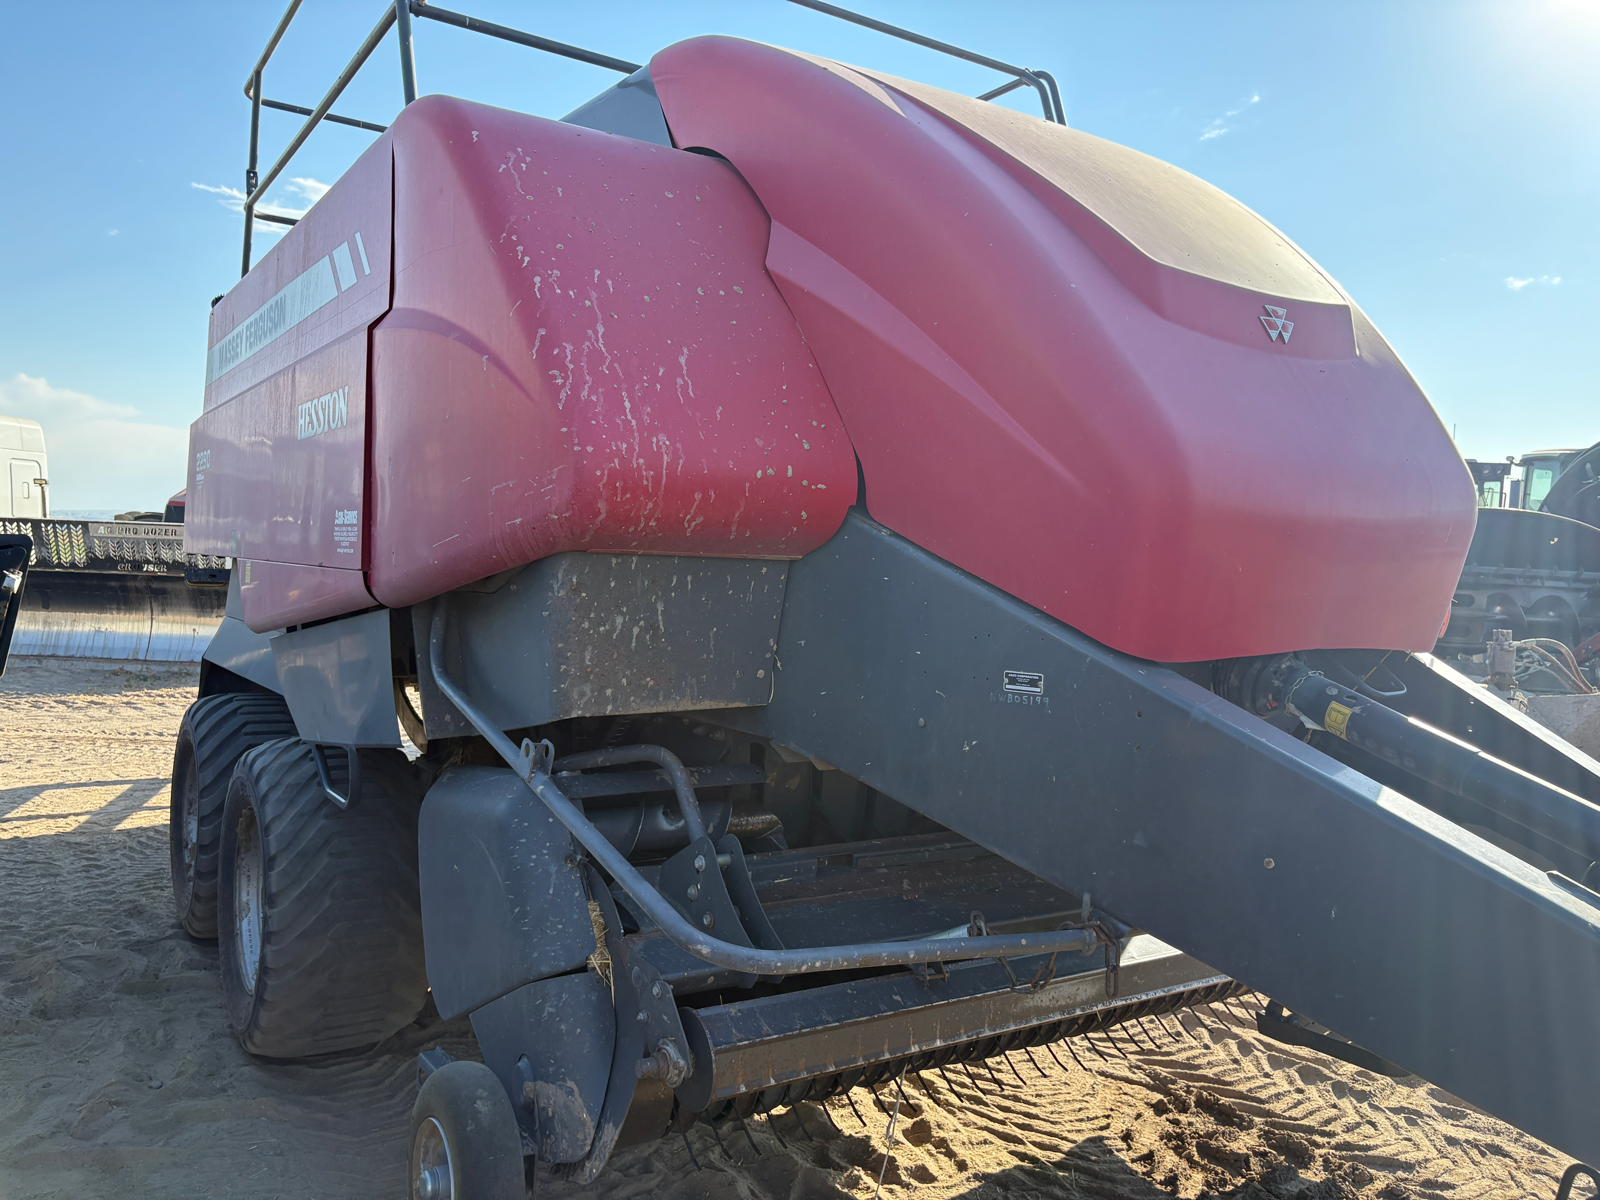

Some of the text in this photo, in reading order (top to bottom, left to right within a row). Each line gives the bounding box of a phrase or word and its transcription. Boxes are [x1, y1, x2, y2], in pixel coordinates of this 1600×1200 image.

[218, 293, 286, 372] MASSEY FERGUSON
[297, 385, 349, 440] HESSTON
[98, 525, 177, 537] AG PRO DOZER
